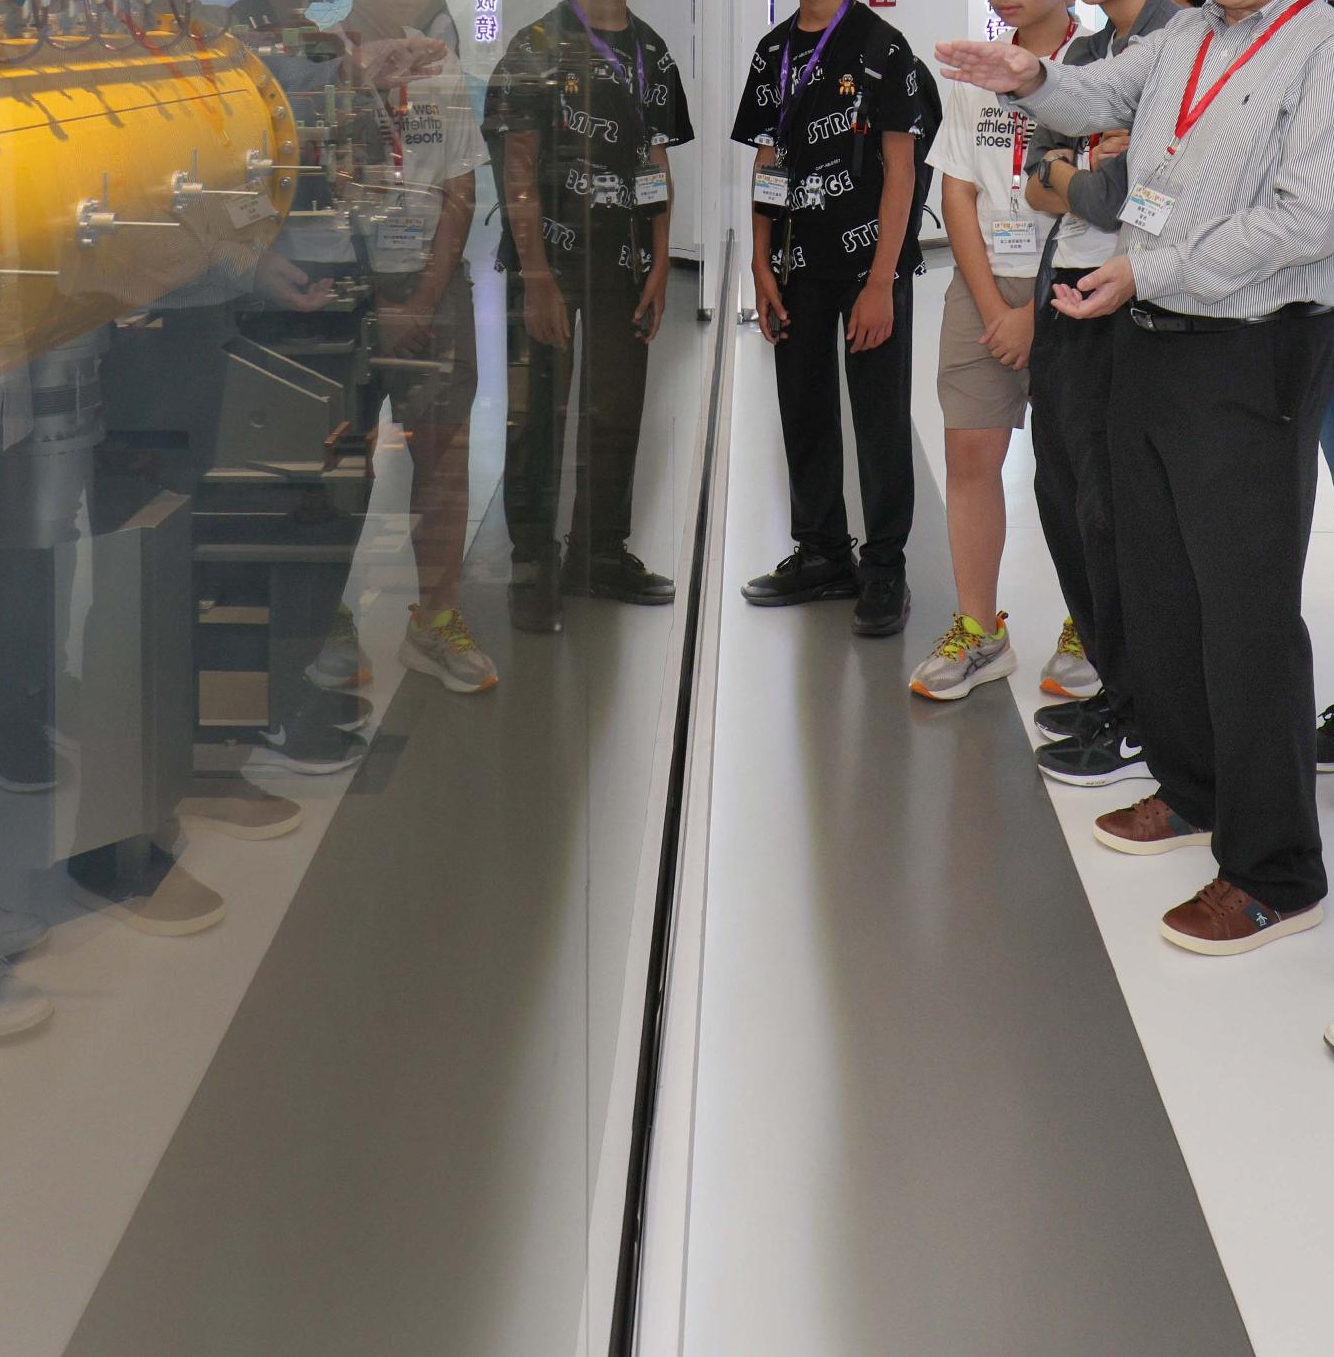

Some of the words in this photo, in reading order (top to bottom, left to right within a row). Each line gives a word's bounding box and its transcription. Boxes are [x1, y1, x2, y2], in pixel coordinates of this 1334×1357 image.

[980, 107, 1004, 118] new
[977, 119, 1024, 135] athletic
[976, 133, 1012, 148] shoes
